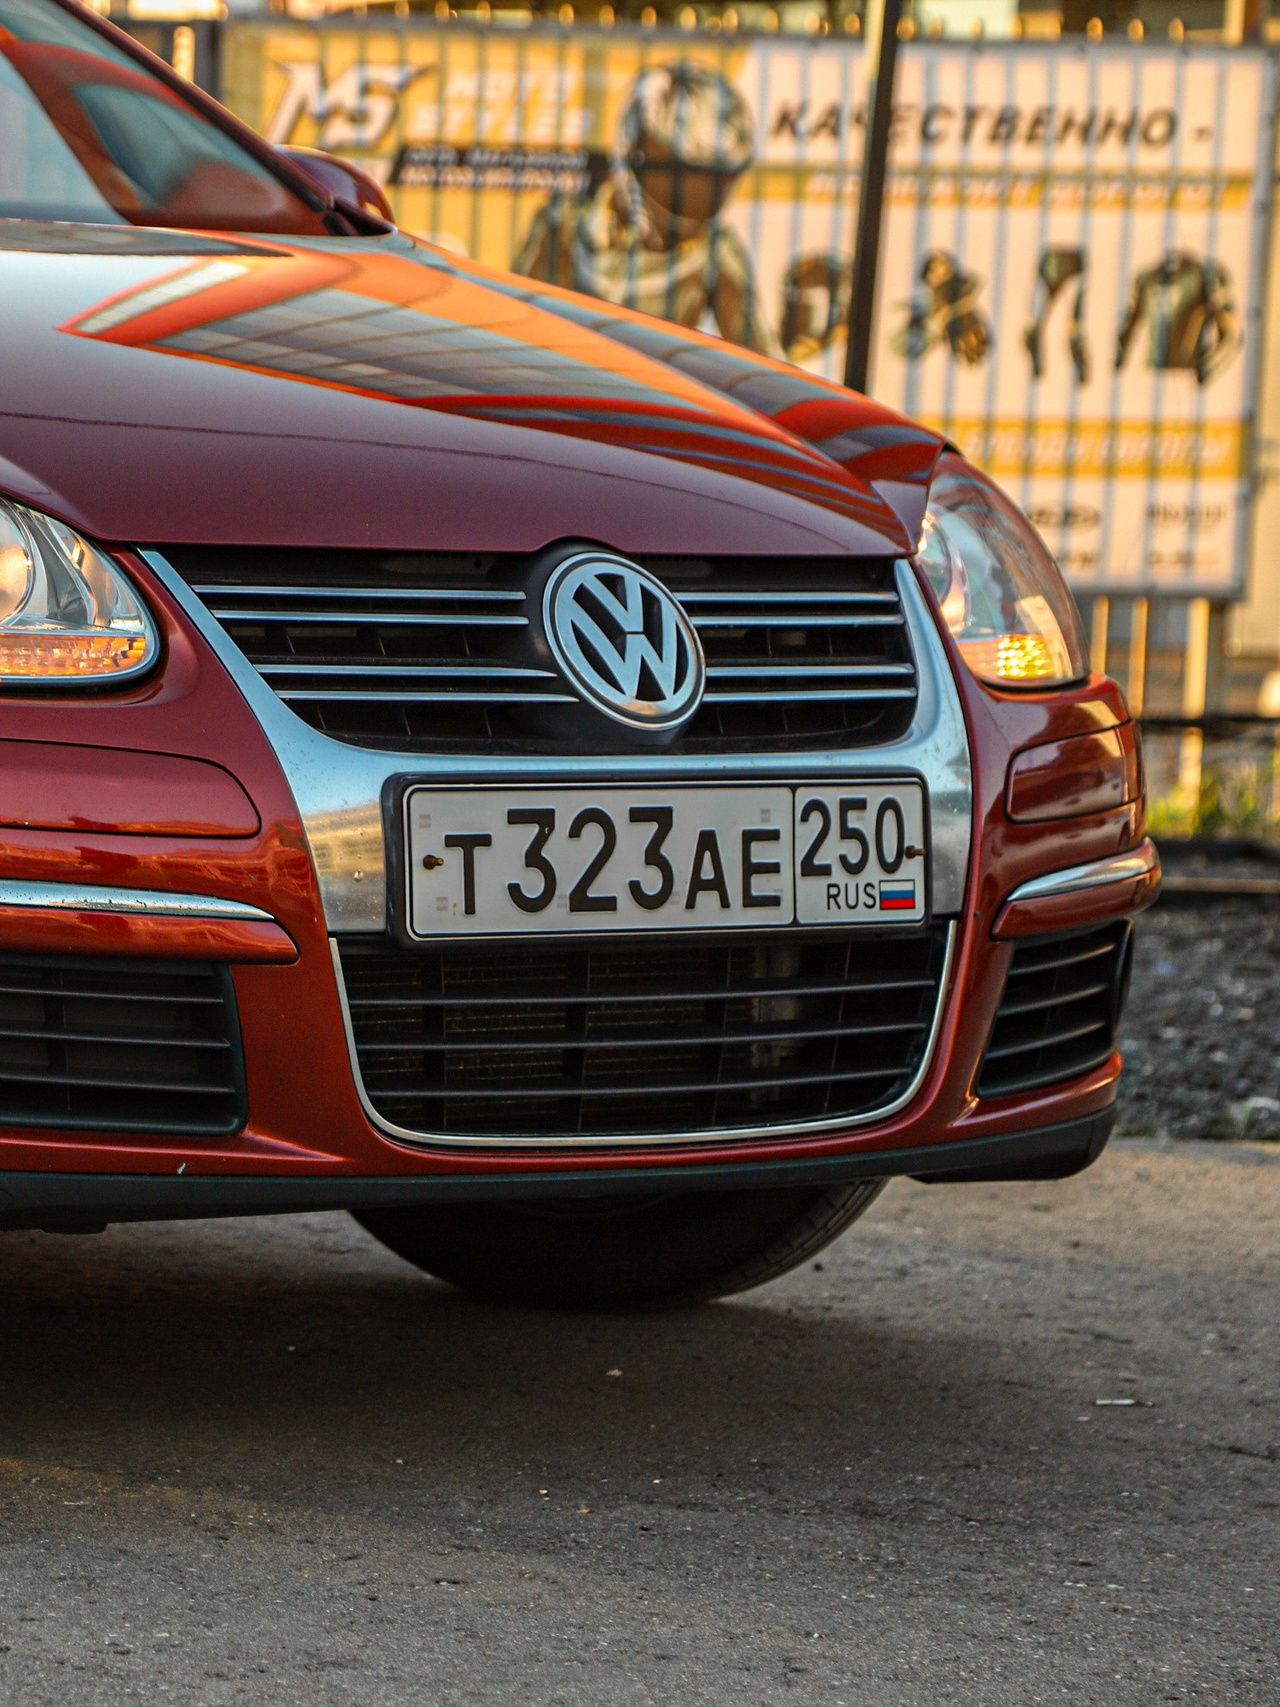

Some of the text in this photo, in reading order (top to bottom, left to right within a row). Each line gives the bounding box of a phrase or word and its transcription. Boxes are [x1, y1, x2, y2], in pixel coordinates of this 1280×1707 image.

[554, 561, 697, 716] VW
[800, 796, 905, 877] 250
[827, 882, 877, 910] RUS
